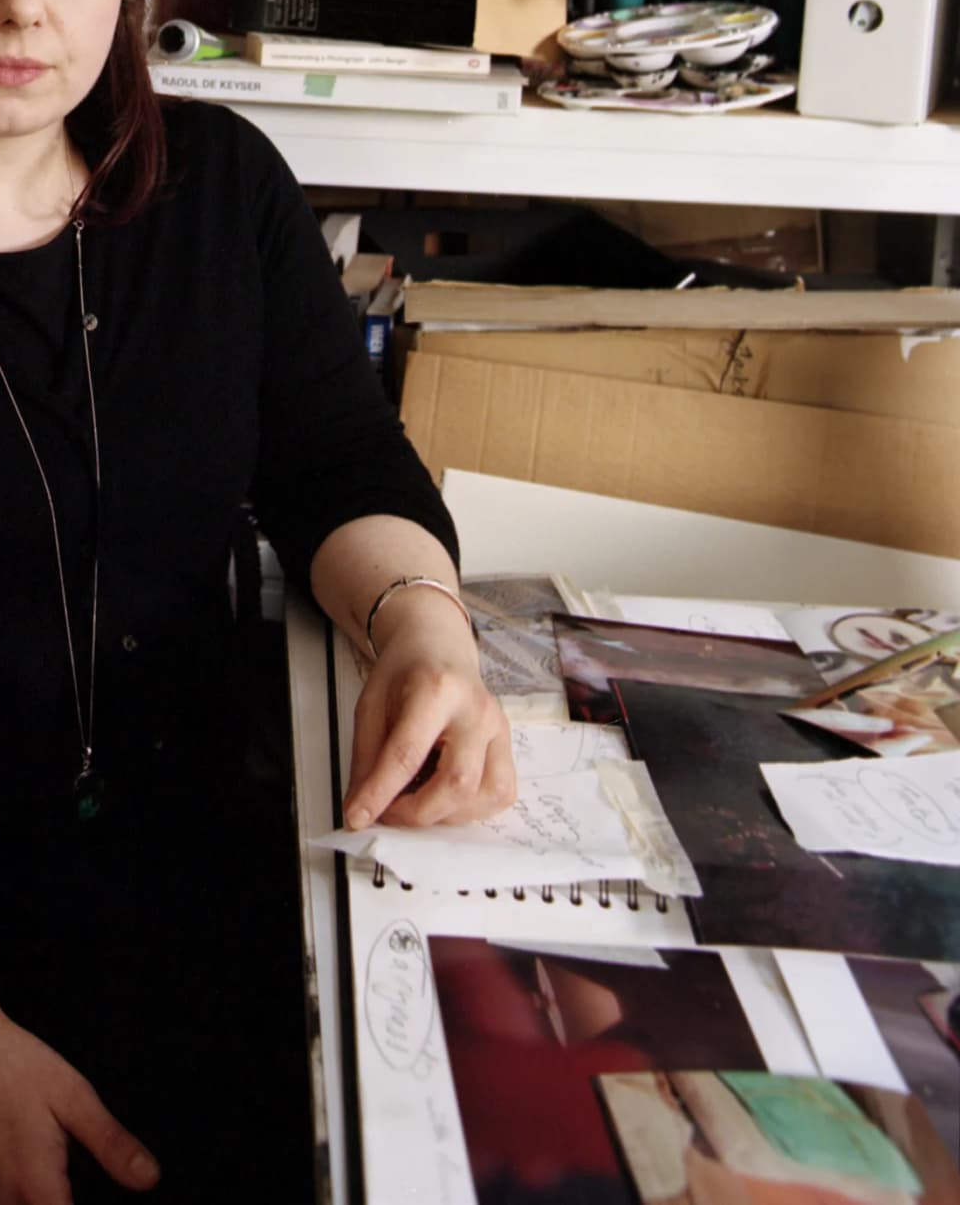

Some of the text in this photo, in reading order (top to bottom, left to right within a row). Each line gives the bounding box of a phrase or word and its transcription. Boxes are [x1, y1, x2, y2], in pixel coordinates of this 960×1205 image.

[161, 75, 262, 92] RAOUL DE KEYSER
